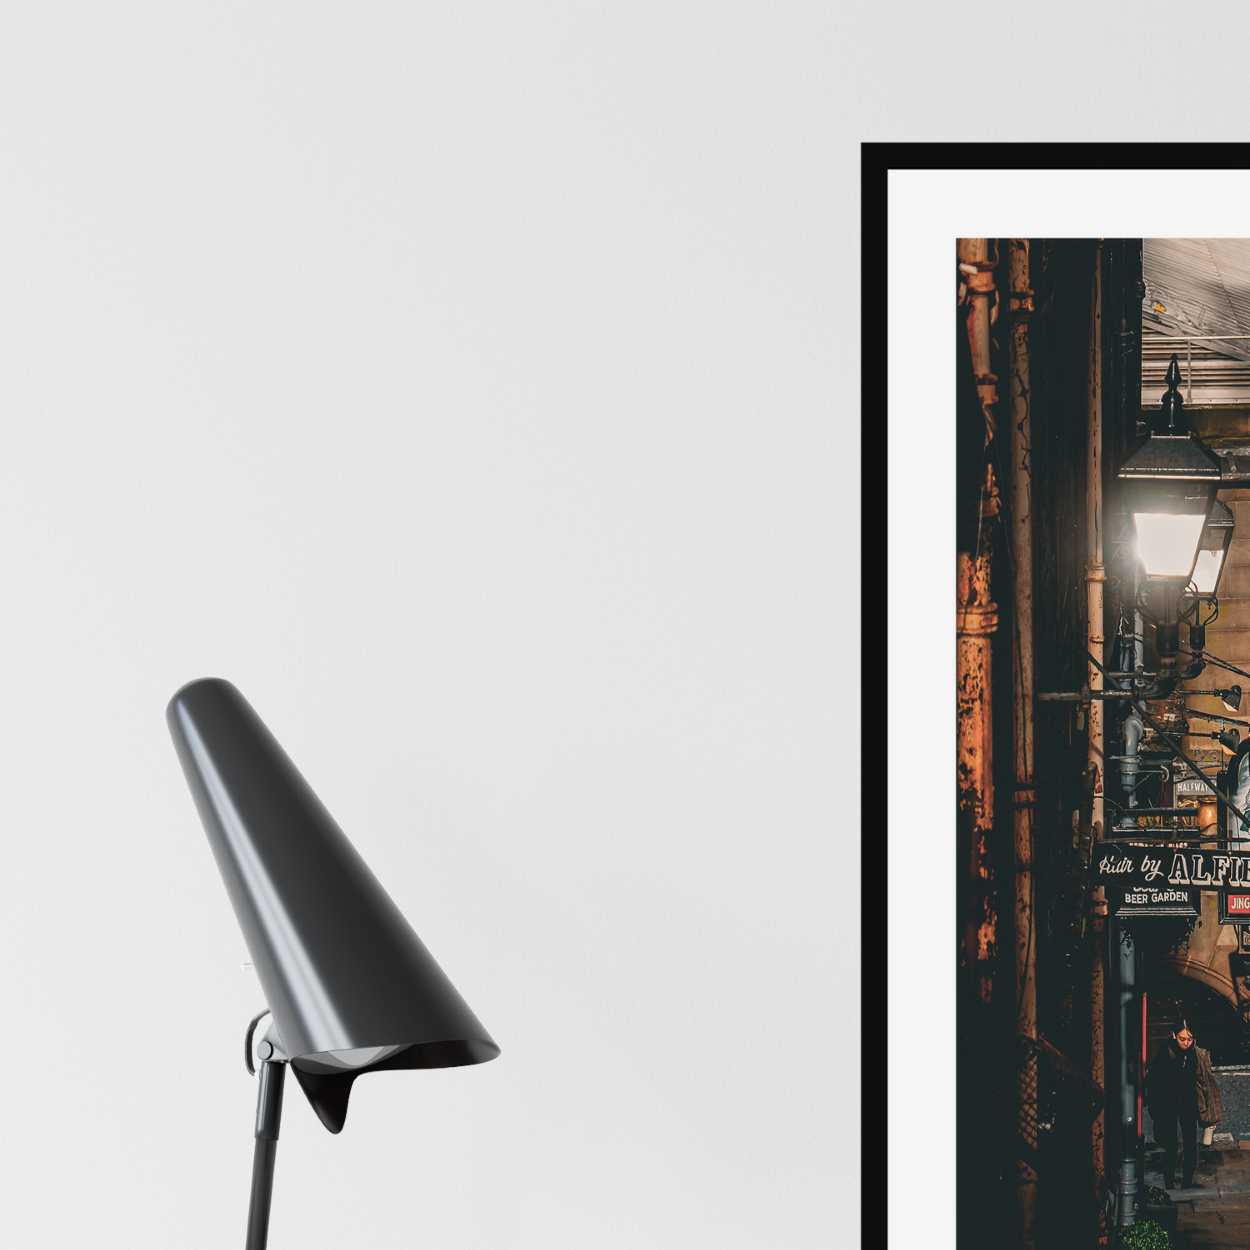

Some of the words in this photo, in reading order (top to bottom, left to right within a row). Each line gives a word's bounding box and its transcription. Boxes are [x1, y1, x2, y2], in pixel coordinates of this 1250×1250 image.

[1177, 782, 1208, 792] HALFWAY
[1140, 855, 1164, 882] by
[1124, 893, 1148, 904] BEER
[1151, 891, 1188, 903] GARDEN
